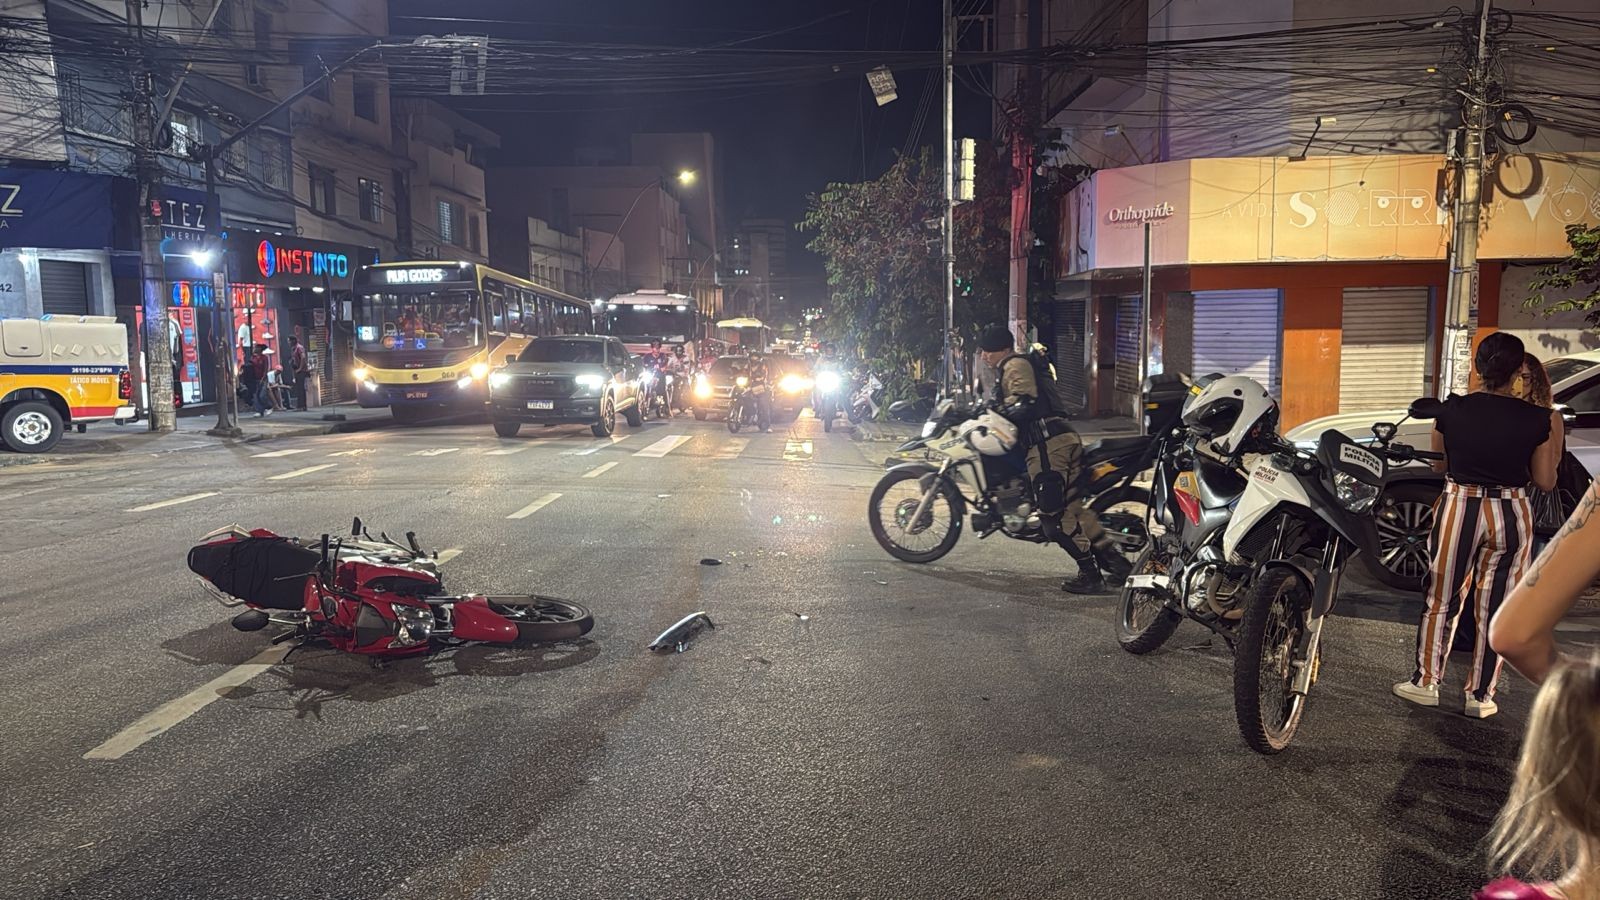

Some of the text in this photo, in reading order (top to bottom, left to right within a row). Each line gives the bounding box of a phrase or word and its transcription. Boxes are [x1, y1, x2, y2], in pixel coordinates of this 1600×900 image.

[161, 200, 206, 229] TEZ
[1108, 202, 1174, 222] Orthopride
[1238, 202, 1280, 218] VIDA
[276, 247, 348, 278] INSTINTO
[1344, 446, 1380, 467] POLÍCIA
[1344, 452, 1380, 473] MILITAR
[1253, 471, 1277, 482] MILITAR
